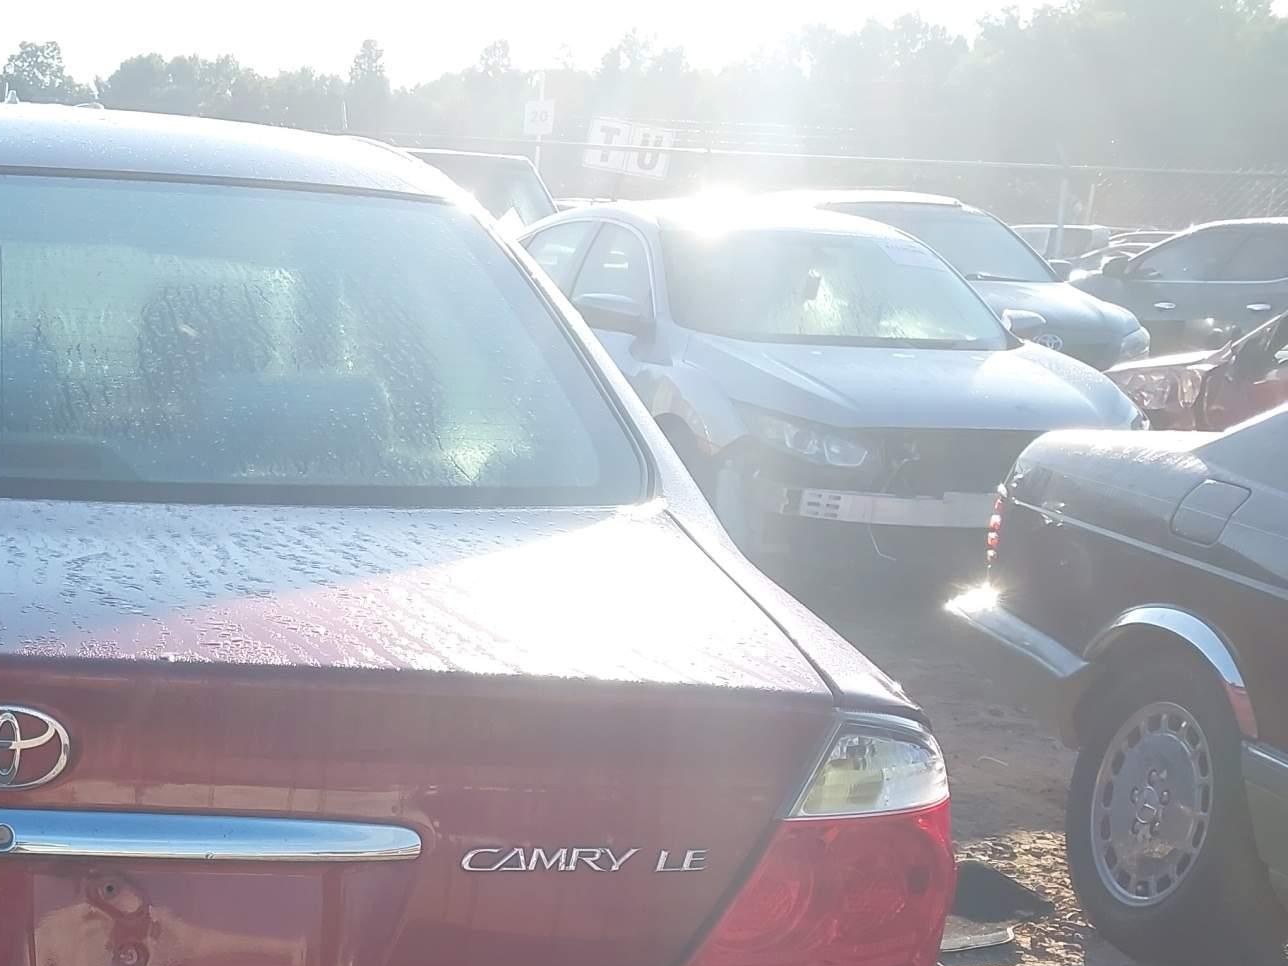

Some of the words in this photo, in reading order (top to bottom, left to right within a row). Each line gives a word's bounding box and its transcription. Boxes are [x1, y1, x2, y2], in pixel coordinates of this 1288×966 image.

[599, 125, 621, 163] T
[461, 848, 640, 872] CAMRY
[655, 849, 711, 872] LE
